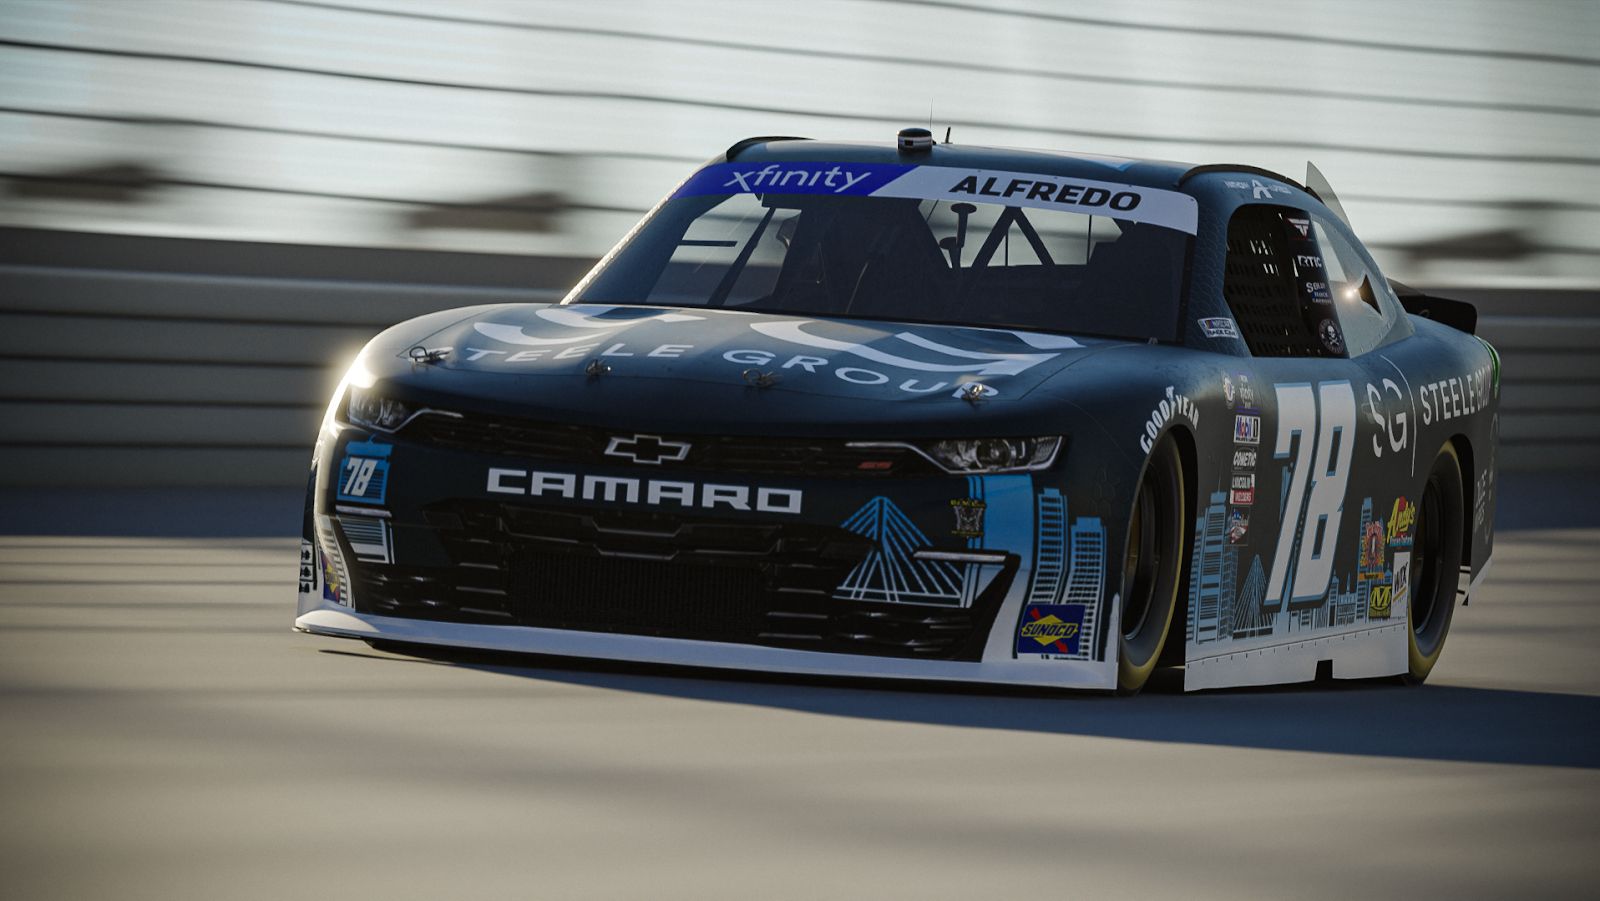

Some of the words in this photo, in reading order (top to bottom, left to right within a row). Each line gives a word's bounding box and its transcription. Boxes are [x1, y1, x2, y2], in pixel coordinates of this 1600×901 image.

[723, 165, 872, 193] xfinity
[948, 175, 1142, 212] ALFREDO
[722, 350, 999, 399] GROUP
[1140, 386, 1199, 455] GOODYEAR
[1419, 374, 1476, 426] STEELE
[343, 457, 378, 497] 78
[487, 468, 802, 514] CAMARO
[1264, 379, 1356, 608] 78
[1022, 621, 1078, 638] SUNOCO
